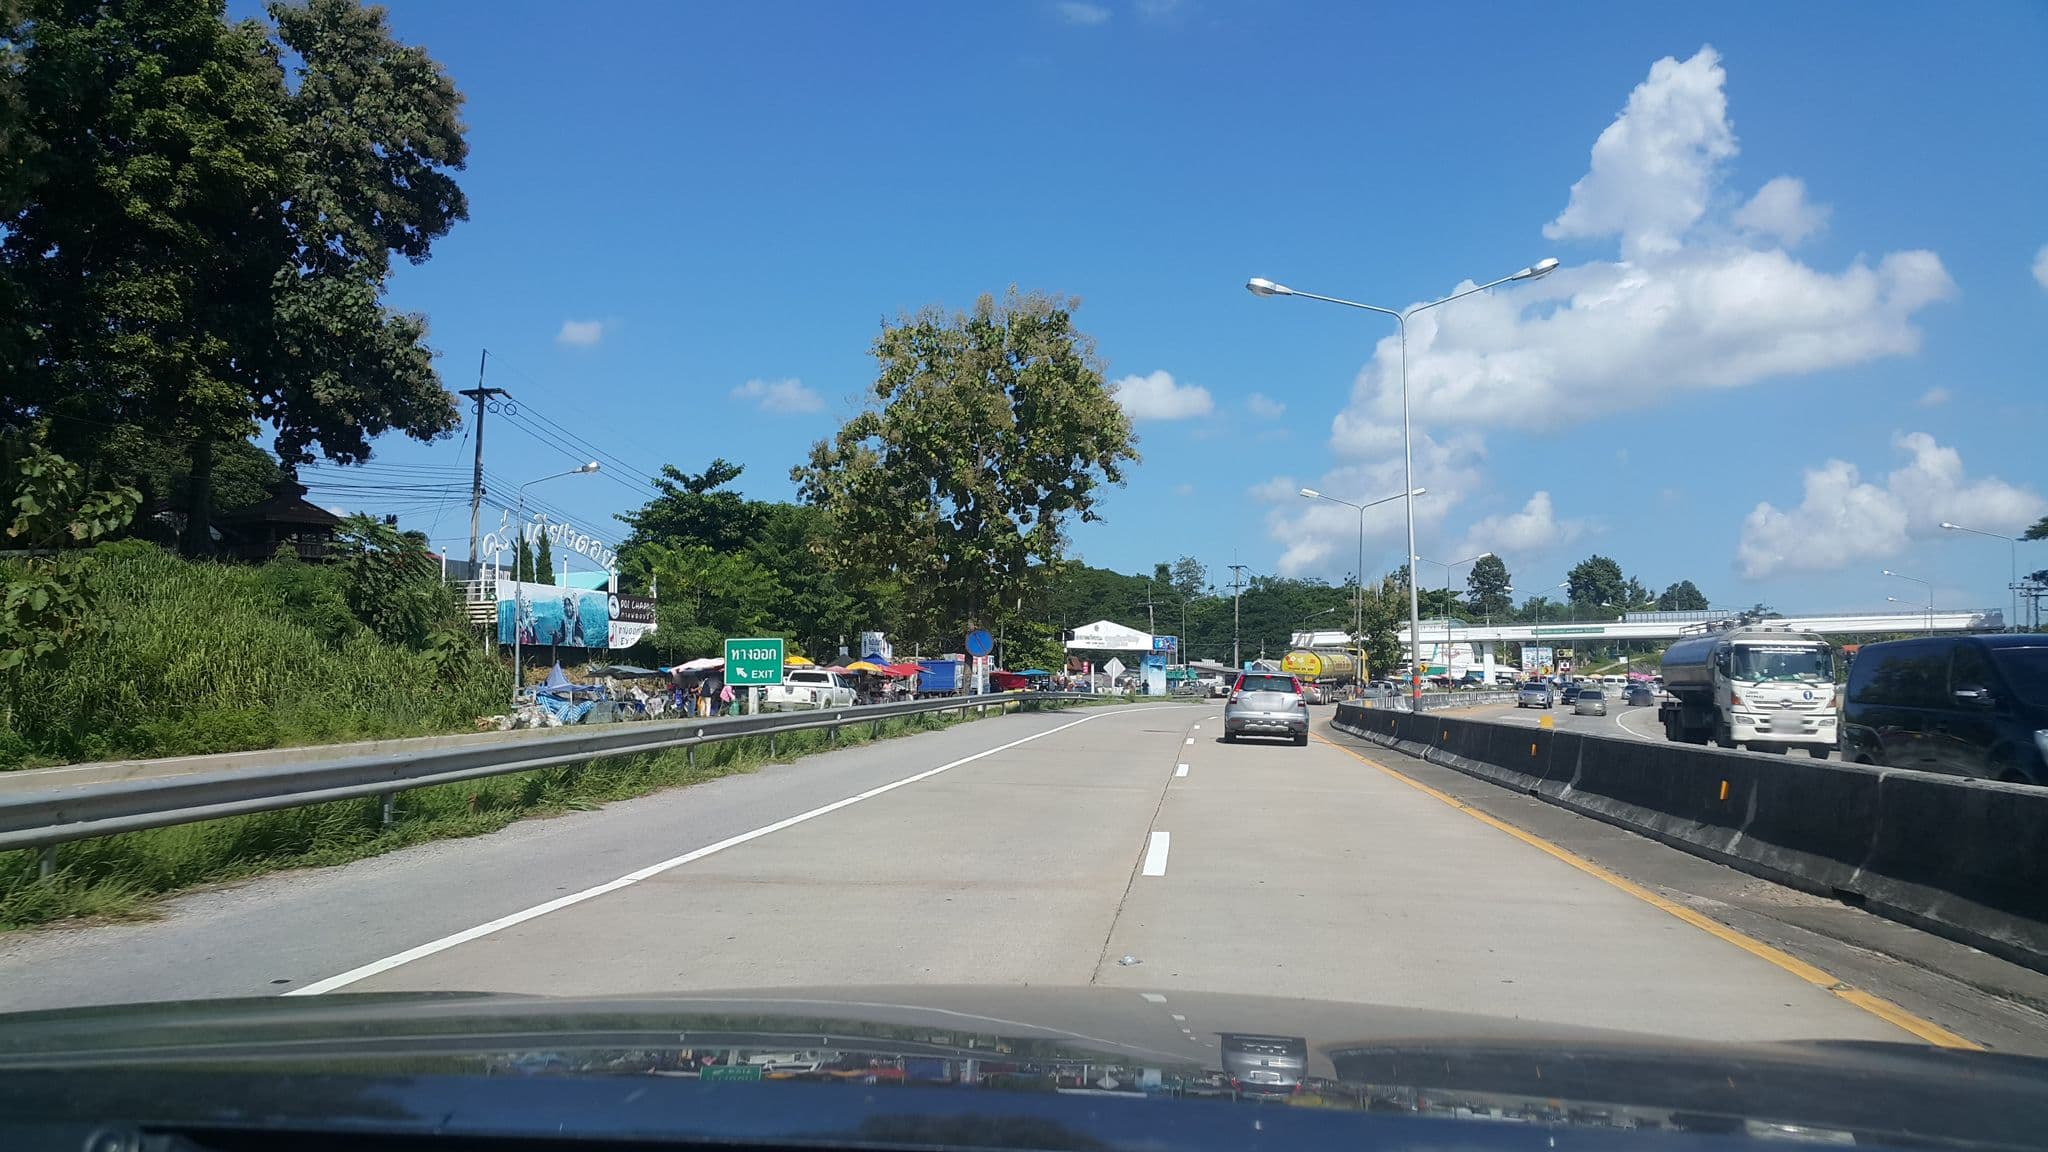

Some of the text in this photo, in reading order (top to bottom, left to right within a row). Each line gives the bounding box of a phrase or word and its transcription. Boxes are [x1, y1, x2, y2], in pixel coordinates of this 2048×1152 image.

[731, 648, 777, 660] ทางออก
[751, 669, 774, 679] EXIT
